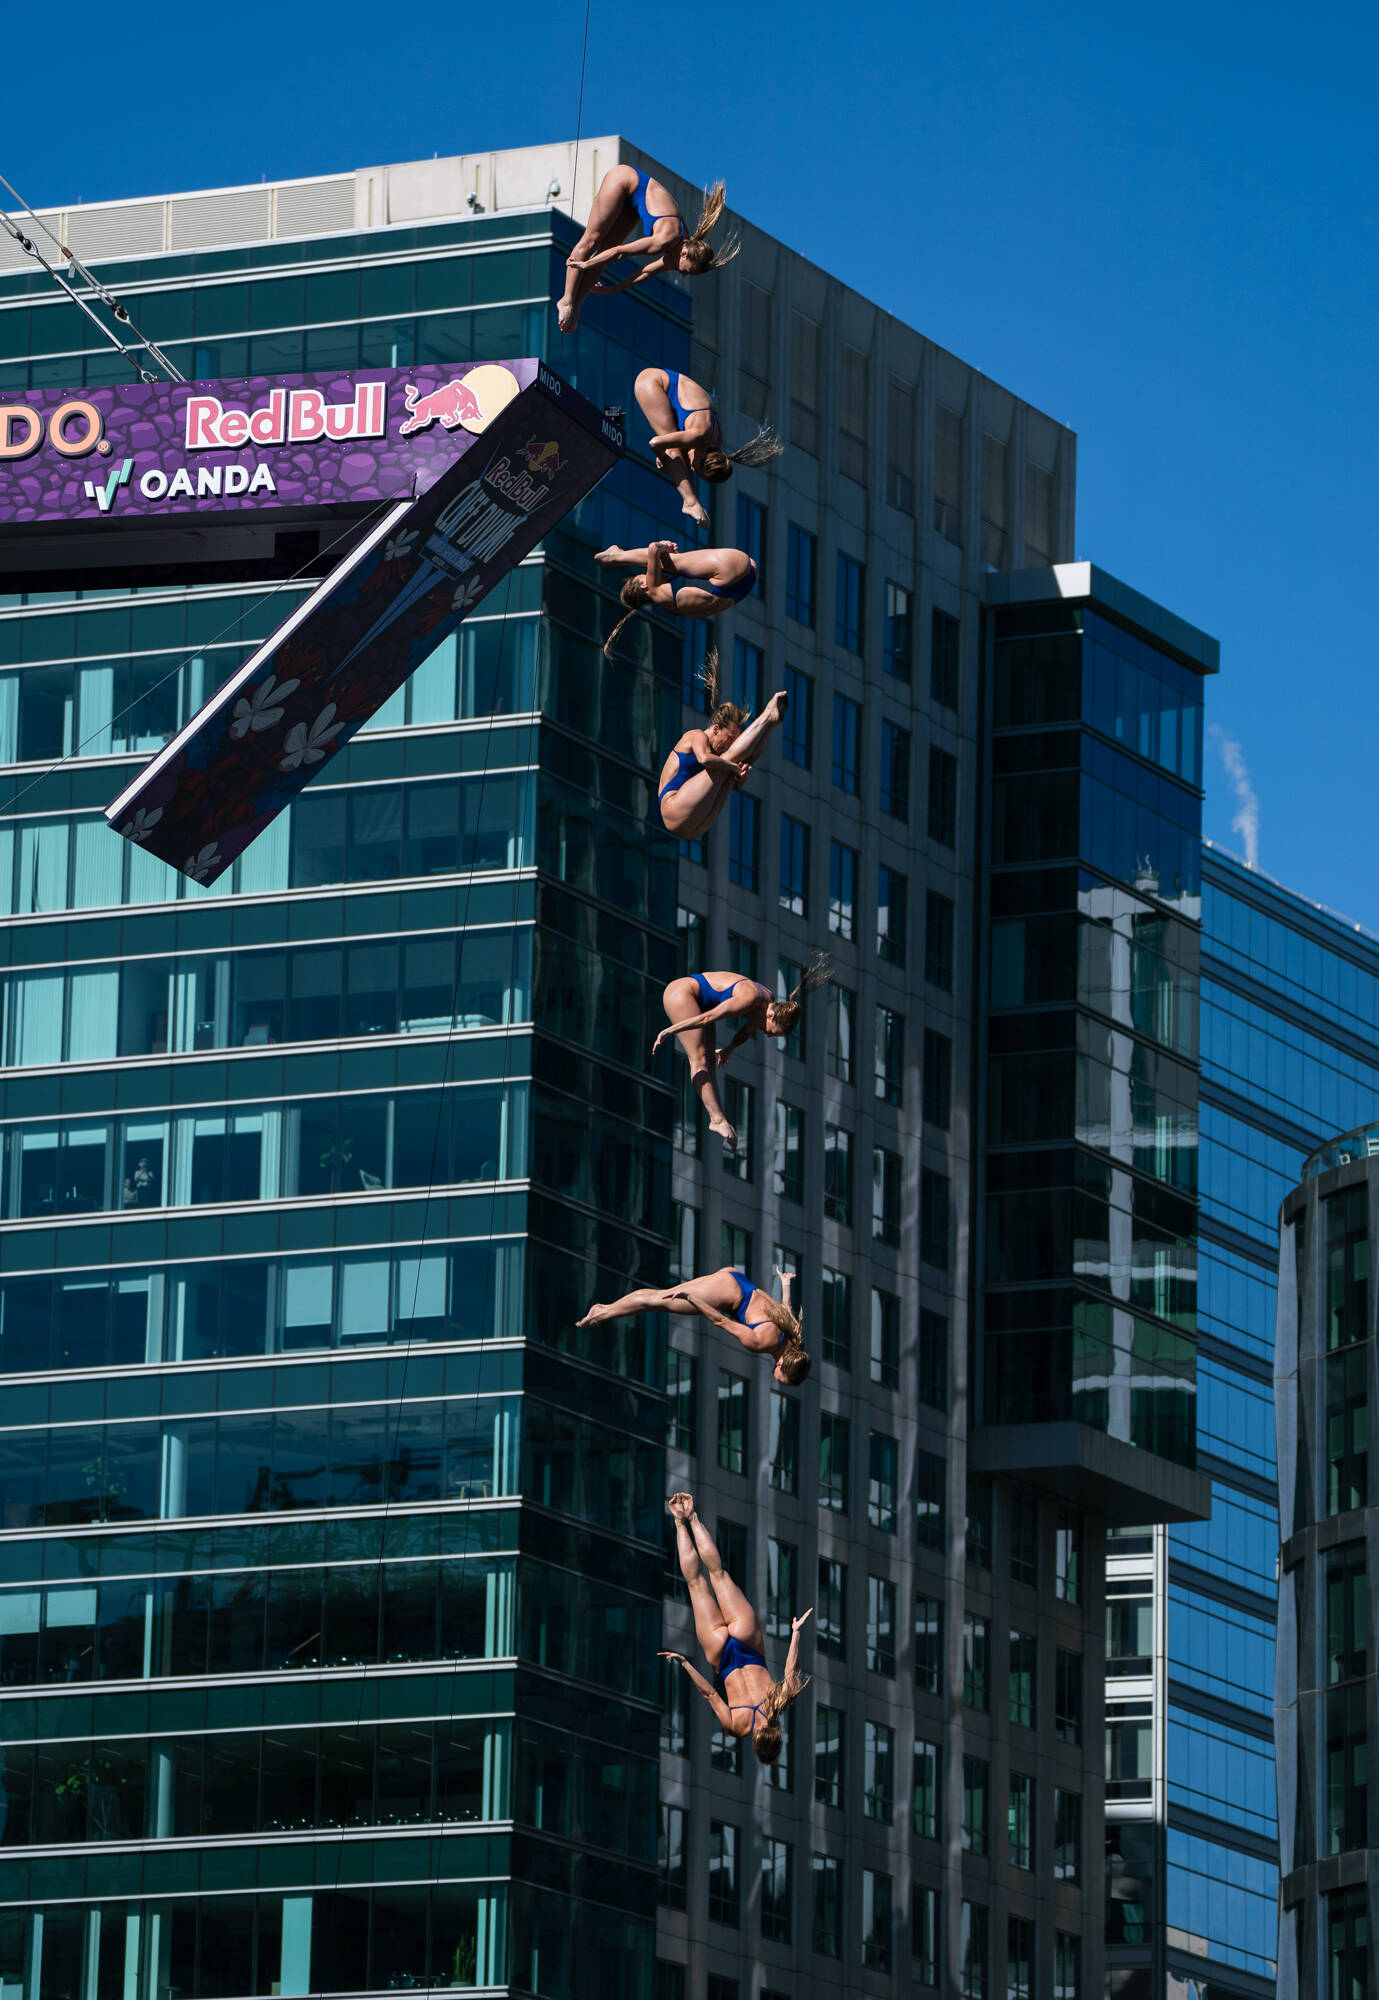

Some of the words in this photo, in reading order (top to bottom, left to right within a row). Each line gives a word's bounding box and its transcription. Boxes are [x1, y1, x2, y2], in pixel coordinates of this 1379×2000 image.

[539, 368, 561, 395] MIDO
[601, 419, 623, 446] MIDO
[140, 463, 276, 499] OANDA
